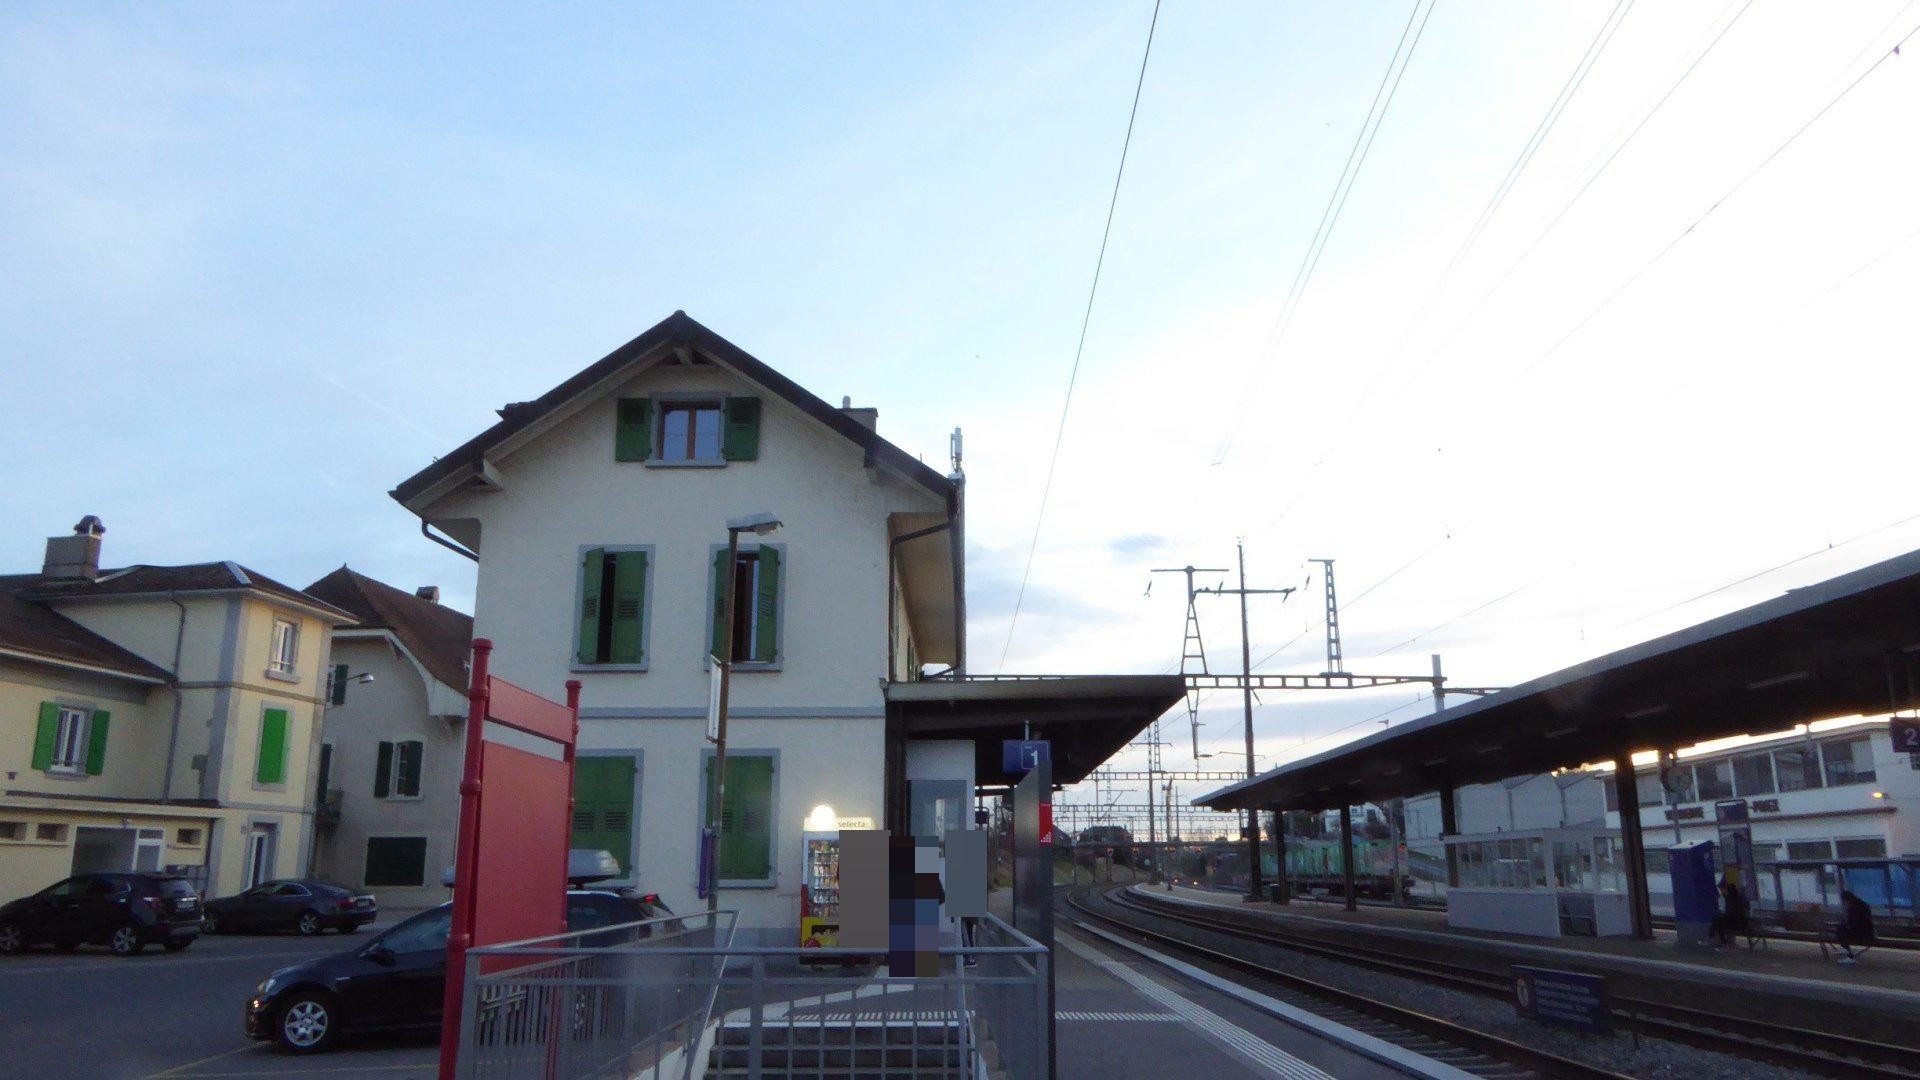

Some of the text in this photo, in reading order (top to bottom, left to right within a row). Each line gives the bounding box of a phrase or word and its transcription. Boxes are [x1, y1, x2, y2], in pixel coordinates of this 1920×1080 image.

[1904, 728, 1919, 746] 2
[1031, 750, 1039, 766] 1
[838, 820, 866, 828] selecta
